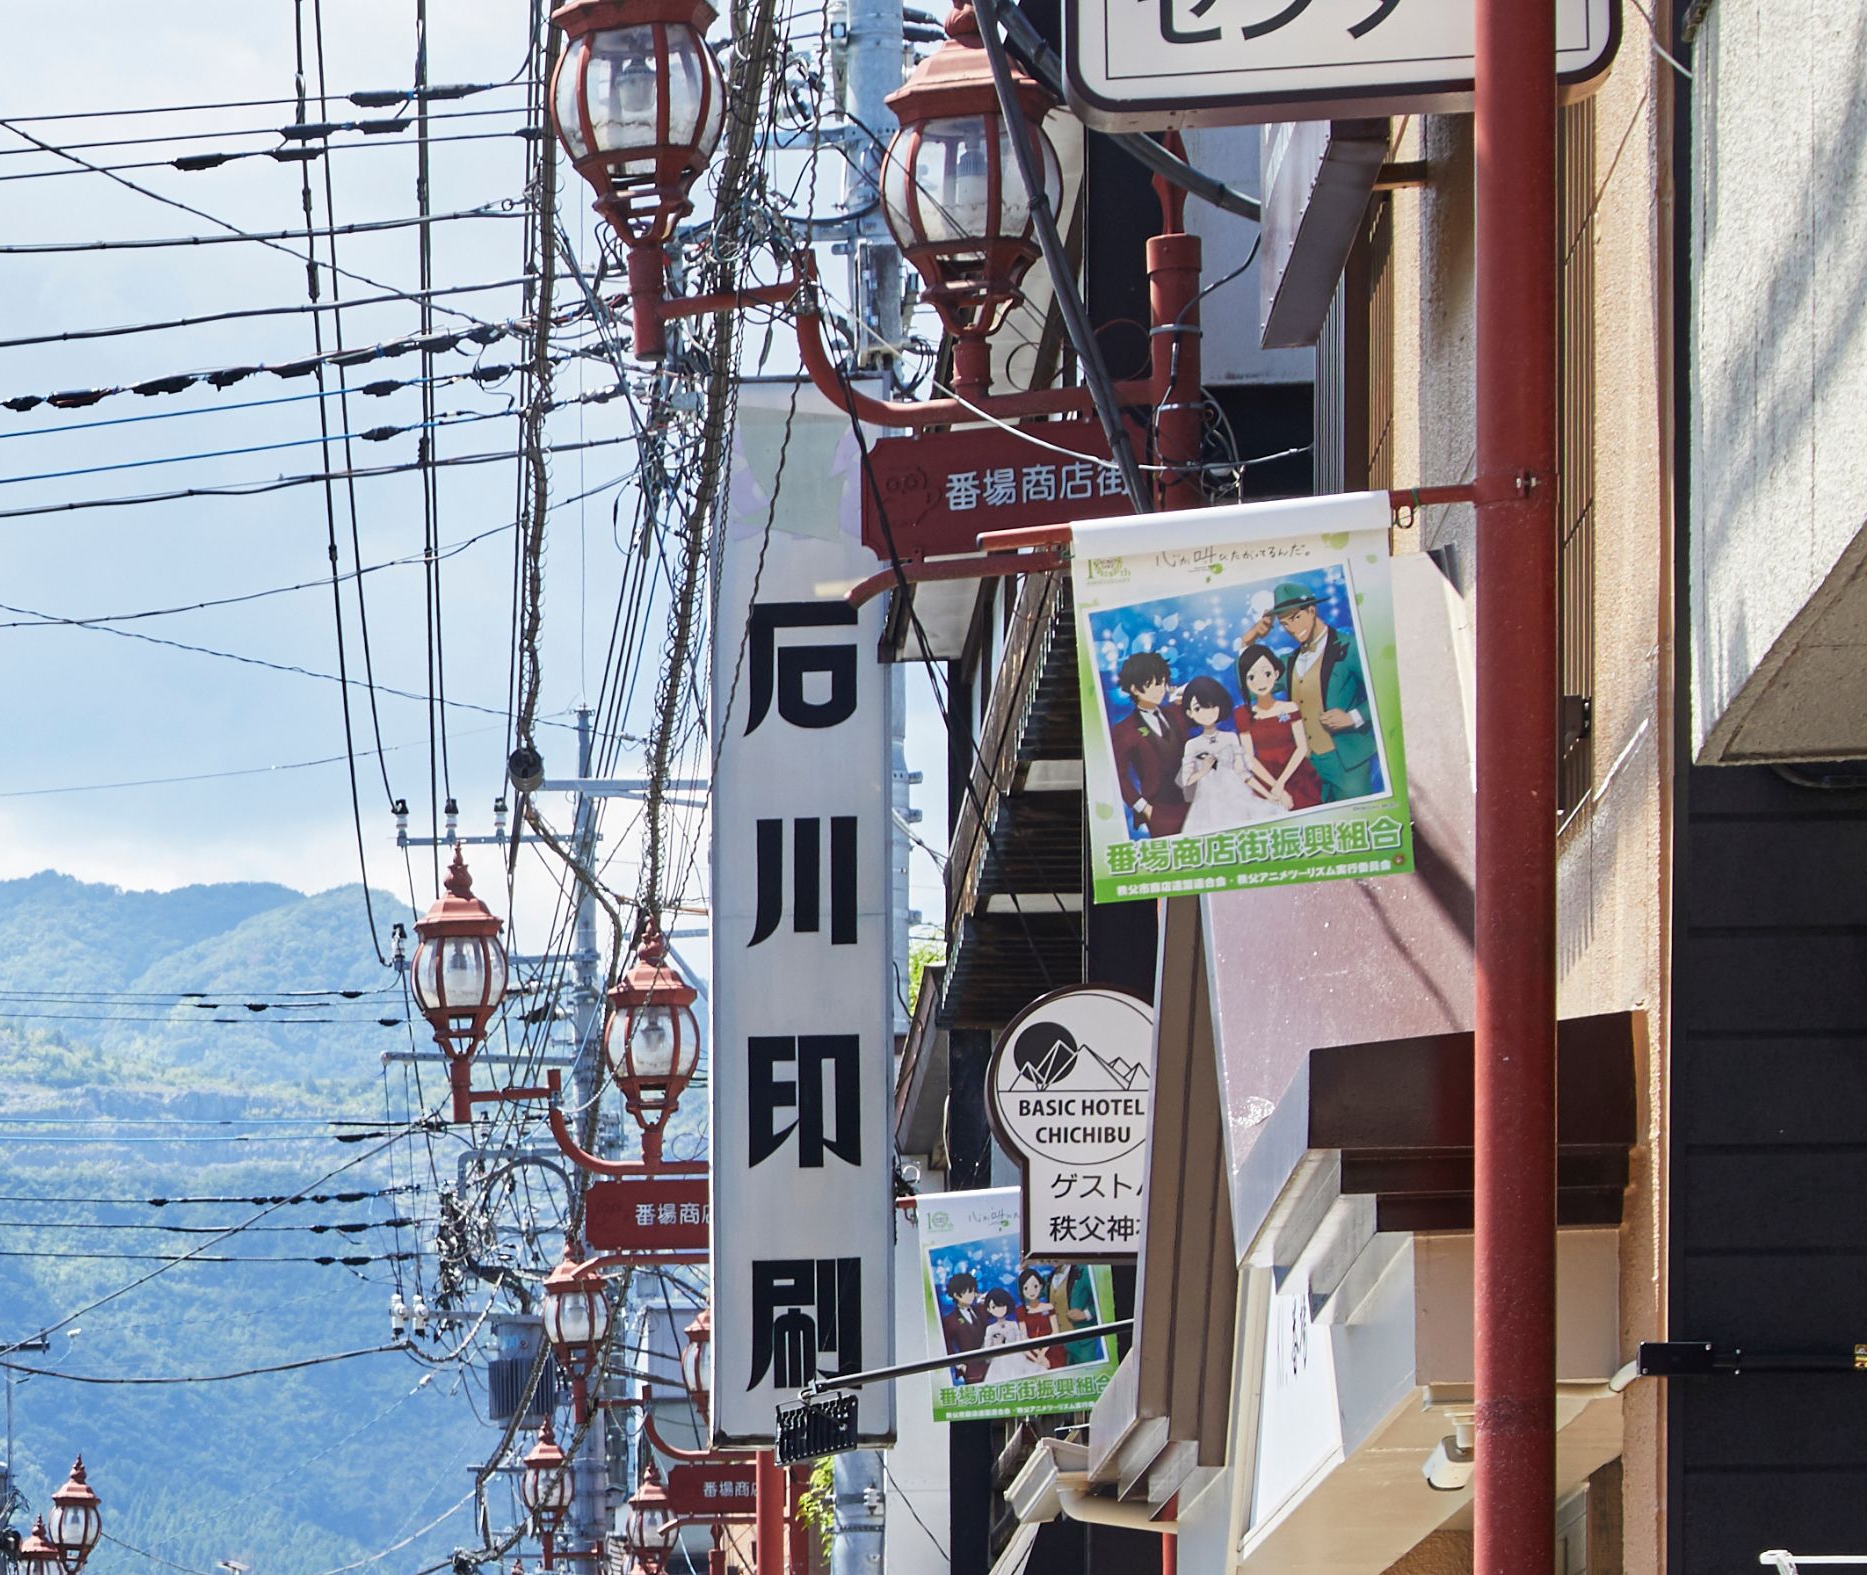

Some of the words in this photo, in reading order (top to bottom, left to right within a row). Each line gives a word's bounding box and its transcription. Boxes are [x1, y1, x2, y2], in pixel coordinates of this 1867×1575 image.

[945, 459, 1131, 511] 番場商店街
[1106, 815, 1404, 875] 番場商店街振興組合
[742, 602, 861, 1390] 石川印刷
[1019, 1099, 1076, 1116] BASIC
[1081, 1099, 1145, 1116] HOTEL
[1036, 1127, 1131, 1144] CHICHIBU
[1050, 1216, 1140, 1242] 秩父神
